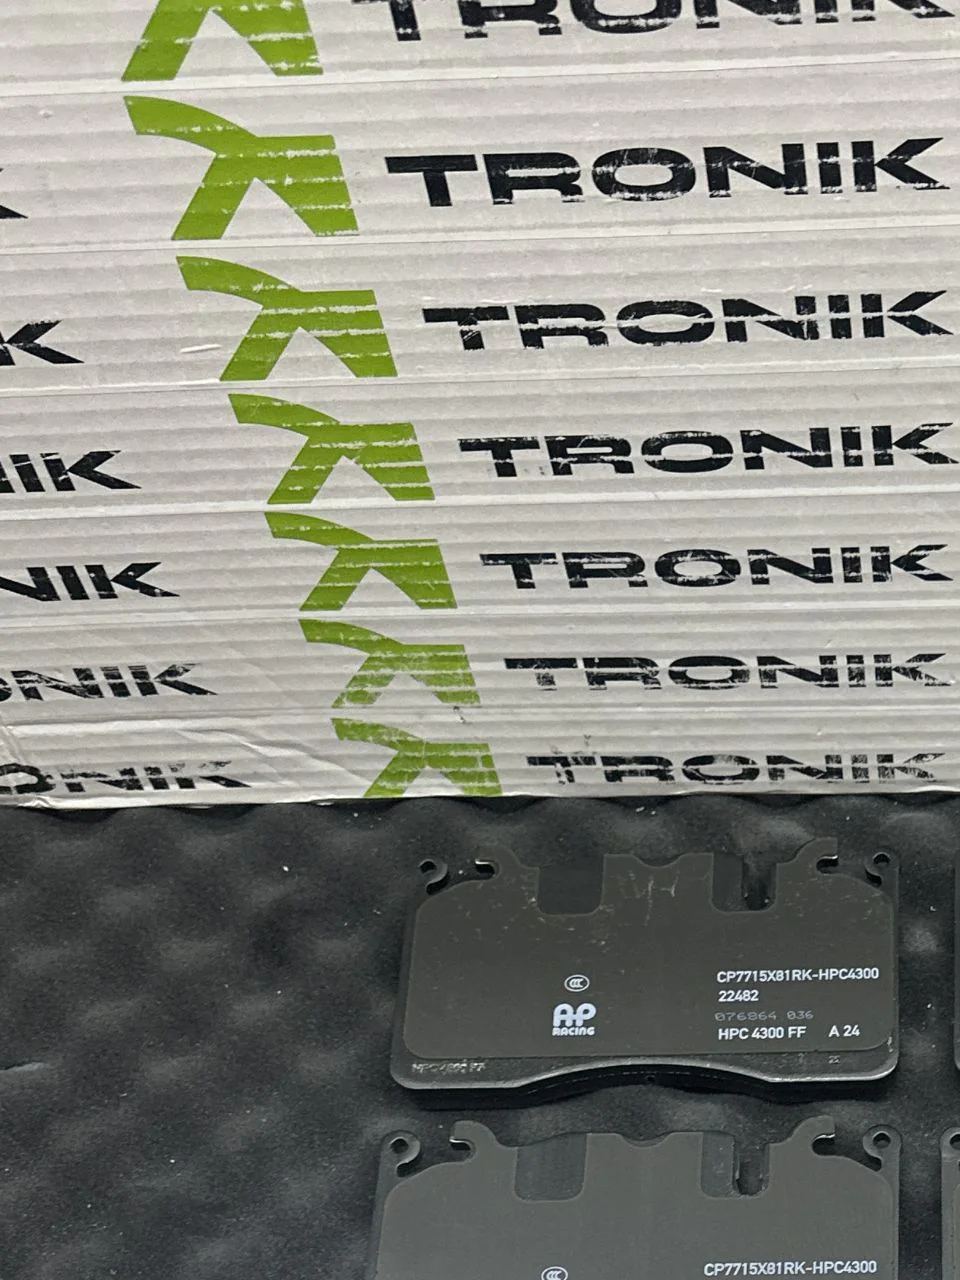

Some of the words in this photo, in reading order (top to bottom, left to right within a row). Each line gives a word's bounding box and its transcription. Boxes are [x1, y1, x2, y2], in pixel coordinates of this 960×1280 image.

[385, 138, 950, 206] TRONIK
[422, 291, 952, 350] TRONIK
[458, 423, 958, 477] TRONIK
[480, 545, 953, 589] TRONIK
[0, 663, 218, 702] NIK
[503, 653, 952, 691] TRONIK
[526, 752, 945, 785] TRONIK
[716, 967, 880, 984] CP7715X81RK-HPC4300
[717, 989, 760, 1003] 22482
[553, 1003, 596, 1027] AP
[714, 1011, 777, 1022] 076864
[786, 1010, 814, 1021] 036
[552, 1027, 594, 1036] RACING
[718, 1027, 750, 1041] HPC
[750, 1026, 785, 1040] 4300
[787, 1025, 807, 1039] FF
[828, 1024, 841, 1038] A
[843, 1024, 861, 1037] 24
[703, 1259, 878, 1277] CP7715X81RK-HPC4300
